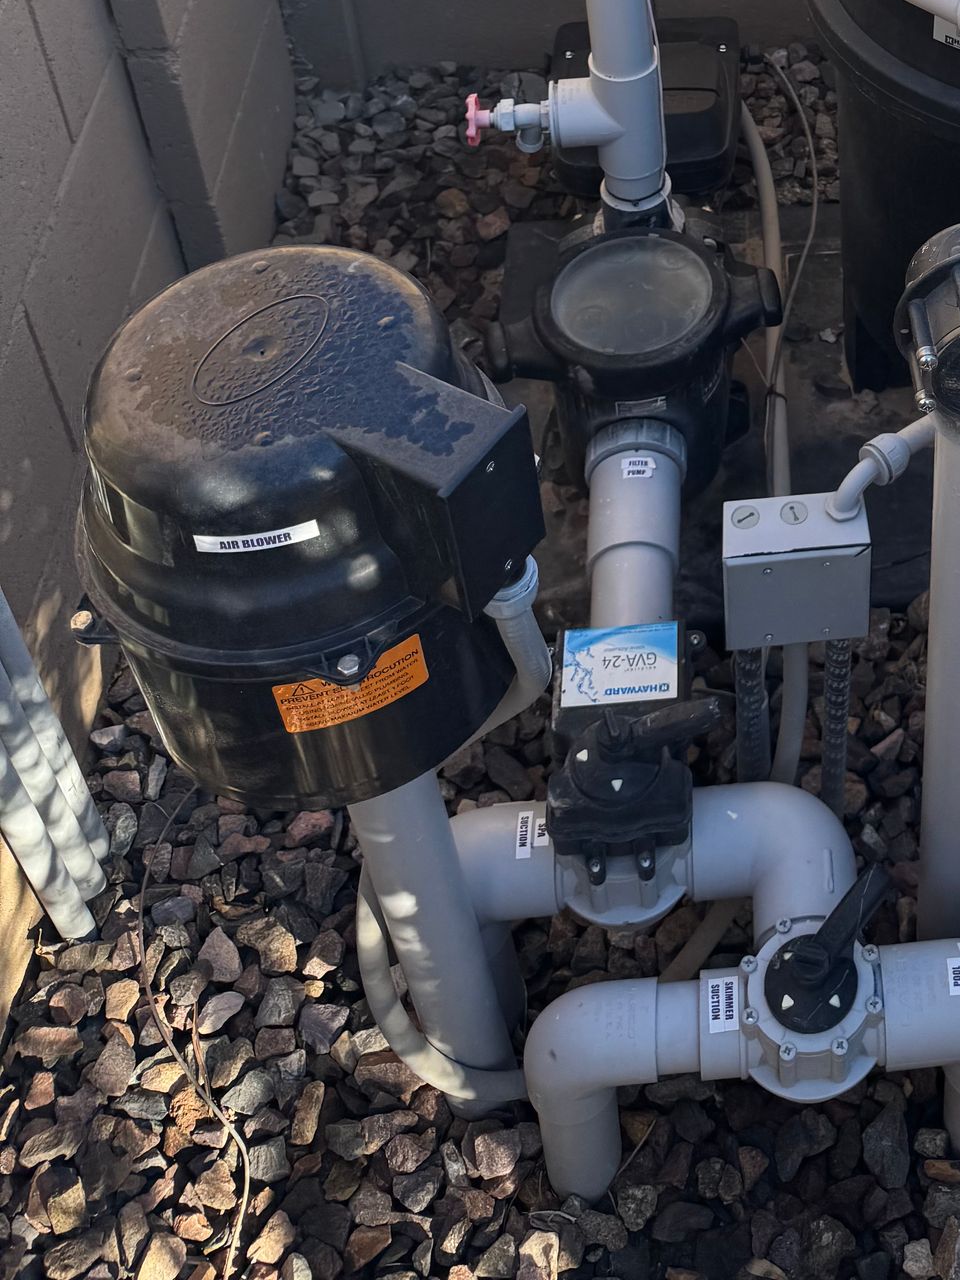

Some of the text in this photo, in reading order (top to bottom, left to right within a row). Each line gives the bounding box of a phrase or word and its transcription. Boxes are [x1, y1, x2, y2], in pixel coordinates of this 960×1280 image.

[220, 532, 292, 550] AIR BLOWER
[602, 652, 657, 669] GVA-24
[280, 689, 330, 704] PREVENT
[603, 683, 658, 696] HAYWARD
[518, 815, 530, 848] SUCTION
[711, 983, 721, 1021] SUCTION
[724, 980, 734, 1021] SKIMMER
